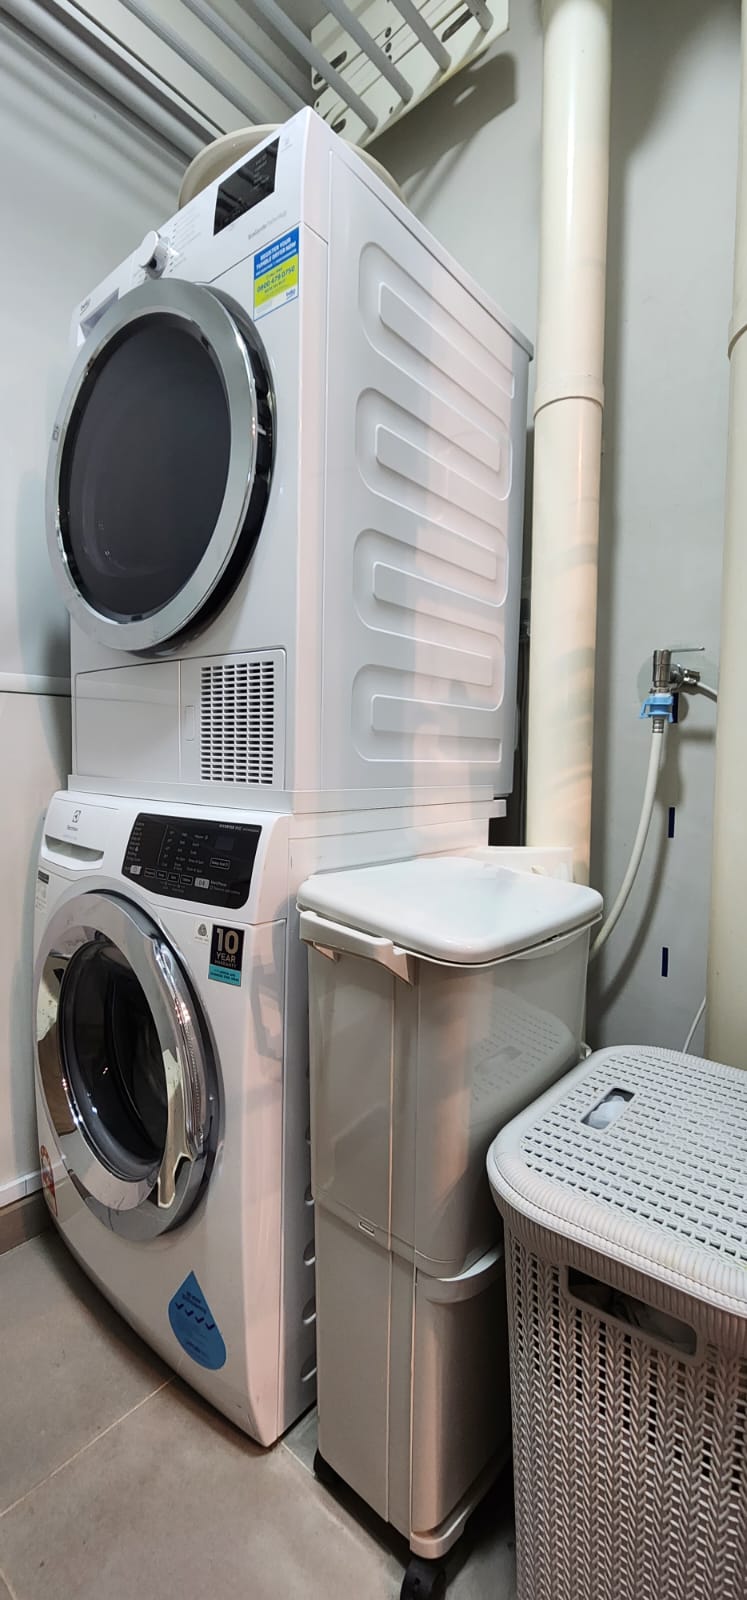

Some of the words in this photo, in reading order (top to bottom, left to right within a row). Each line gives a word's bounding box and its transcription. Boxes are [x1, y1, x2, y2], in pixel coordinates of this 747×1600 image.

[280, 237, 291, 249] YOUR
[216, 928, 239, 954] 10
[216, 951, 236, 962] YEAR
